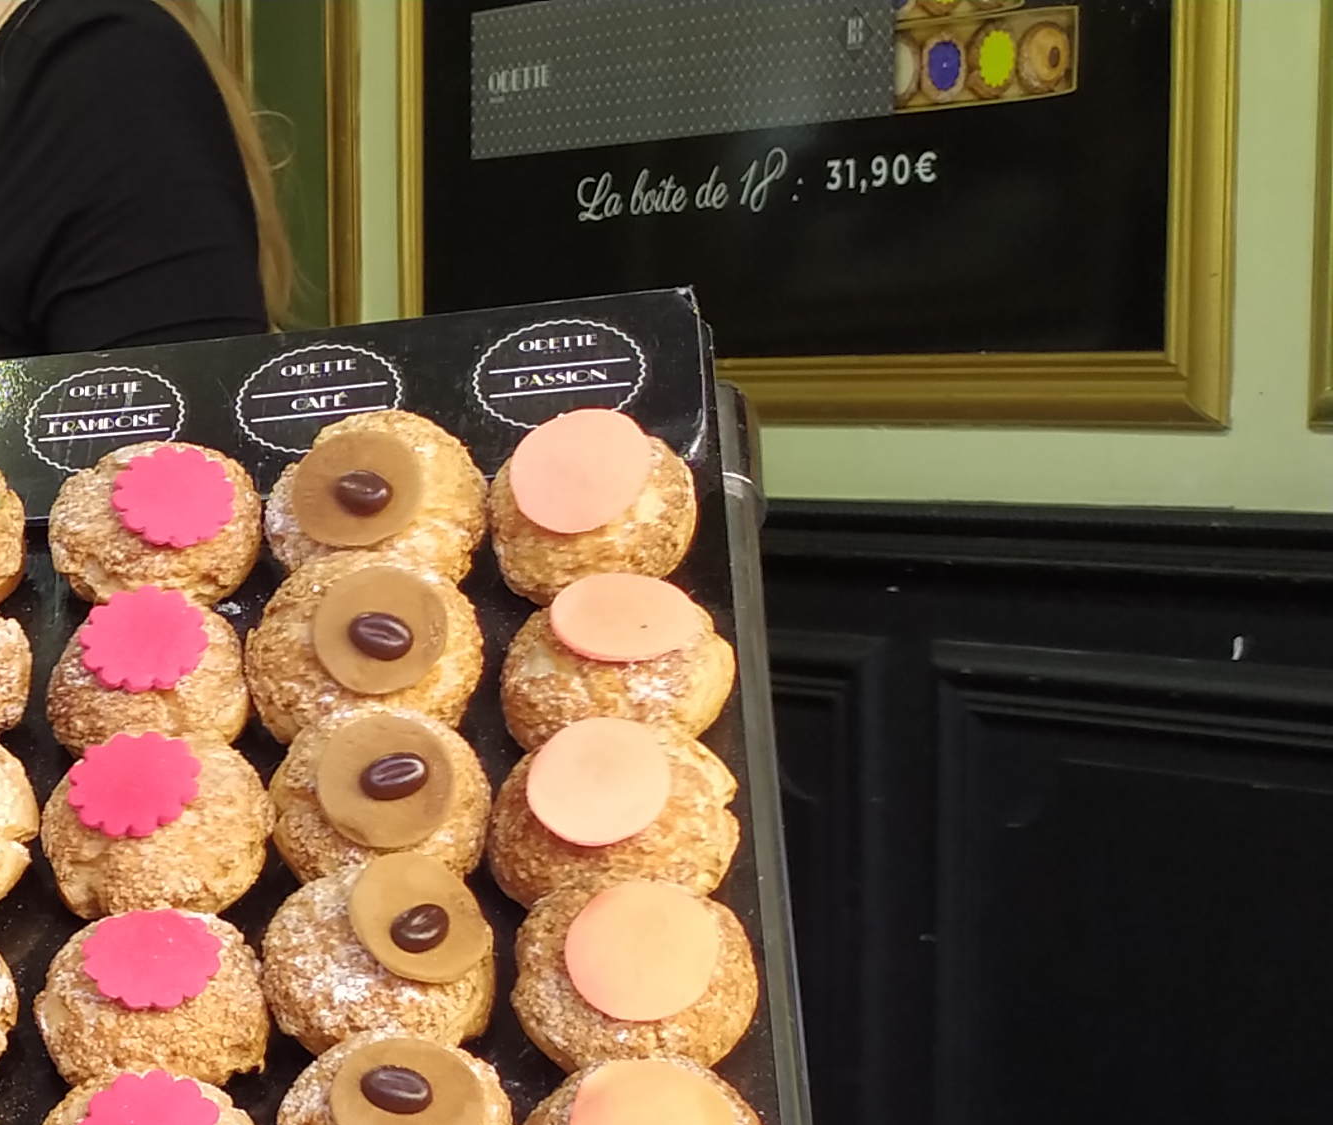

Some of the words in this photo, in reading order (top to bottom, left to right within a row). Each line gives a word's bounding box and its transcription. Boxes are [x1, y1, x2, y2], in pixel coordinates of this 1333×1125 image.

[577, 172, 624, 221] La
[630, 168, 688, 216] boîte
[695, 165, 730, 209] de
[740, 146, 788, 212] 18
[825, 151, 938, 193] 31,90€
[518, 333, 597, 352] ODETTE
[281, 359, 357, 377] ODETTE
[514, 367, 608, 388] PASSION
[69, 381, 142, 397] ODETTE
[291, 391, 348, 411] CAFÉ
[47, 412, 161, 434] FRAMBOISE
